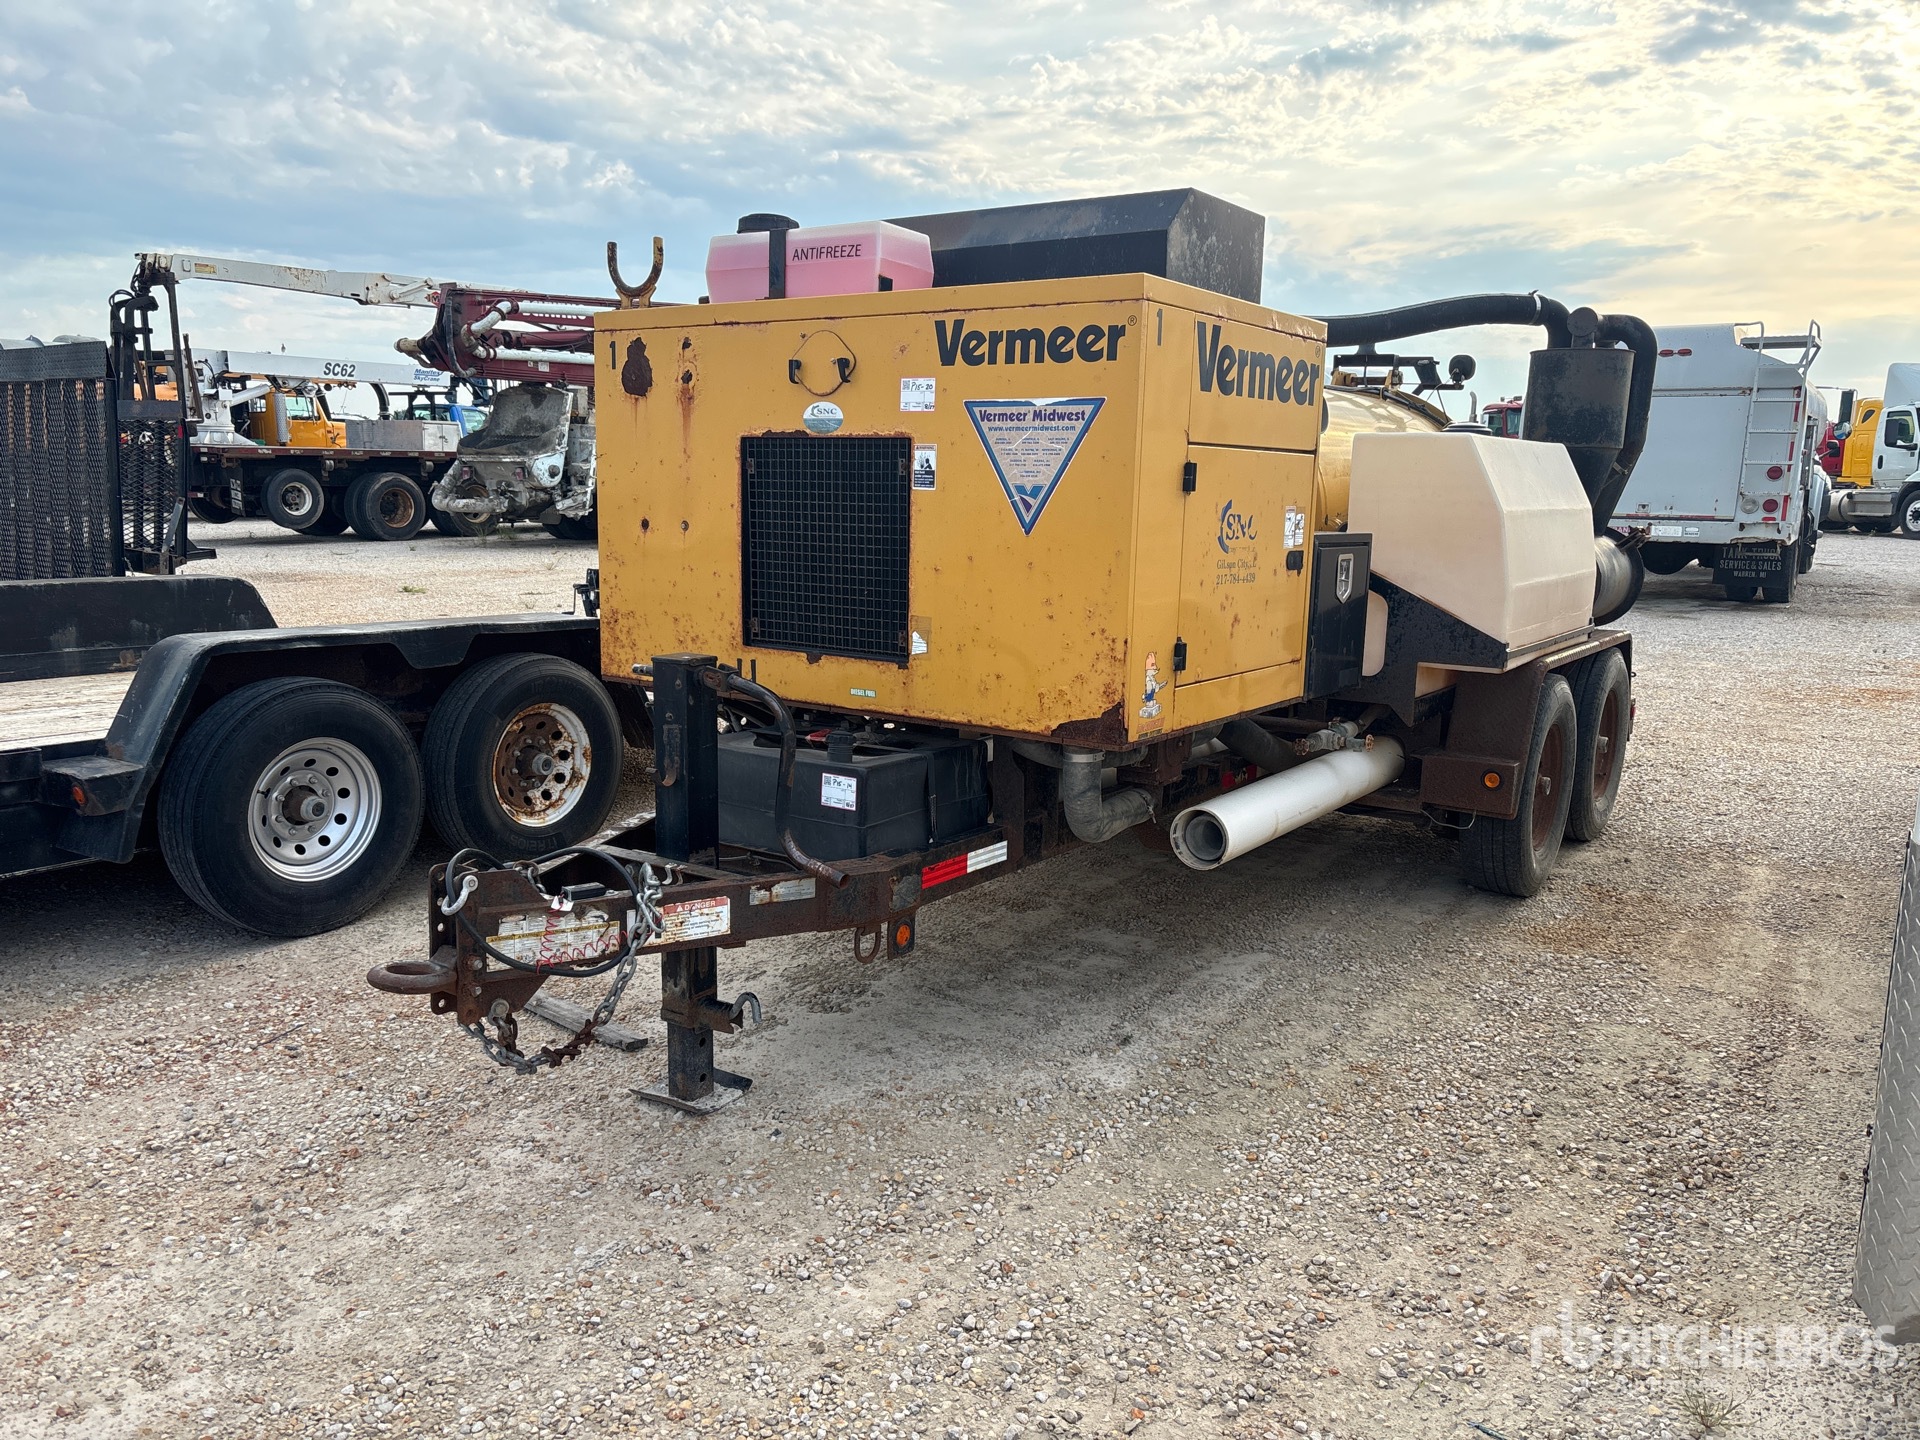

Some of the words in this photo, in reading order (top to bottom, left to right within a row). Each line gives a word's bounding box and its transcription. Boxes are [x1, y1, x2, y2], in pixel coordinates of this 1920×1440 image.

[792, 244, 862, 261] ANTIFREEZE
[1156, 308, 1164, 347] 1
[934, 318, 1127, 367] Vermeer
[609, 340, 617, 370] 1
[323, 362, 356, 378] SC62
[1196, 320, 1320, 407] Vermeer
[979, 409, 1030, 422] Vermeer
[1032, 408, 1086, 422] Midwest
[987, 424, 1076, 432] www.vermeermidwest.com
[1722, 547, 1748, 559] TANK
[1758, 561, 1782, 571] SALES
[684, 900, 716, 911] DANGER
